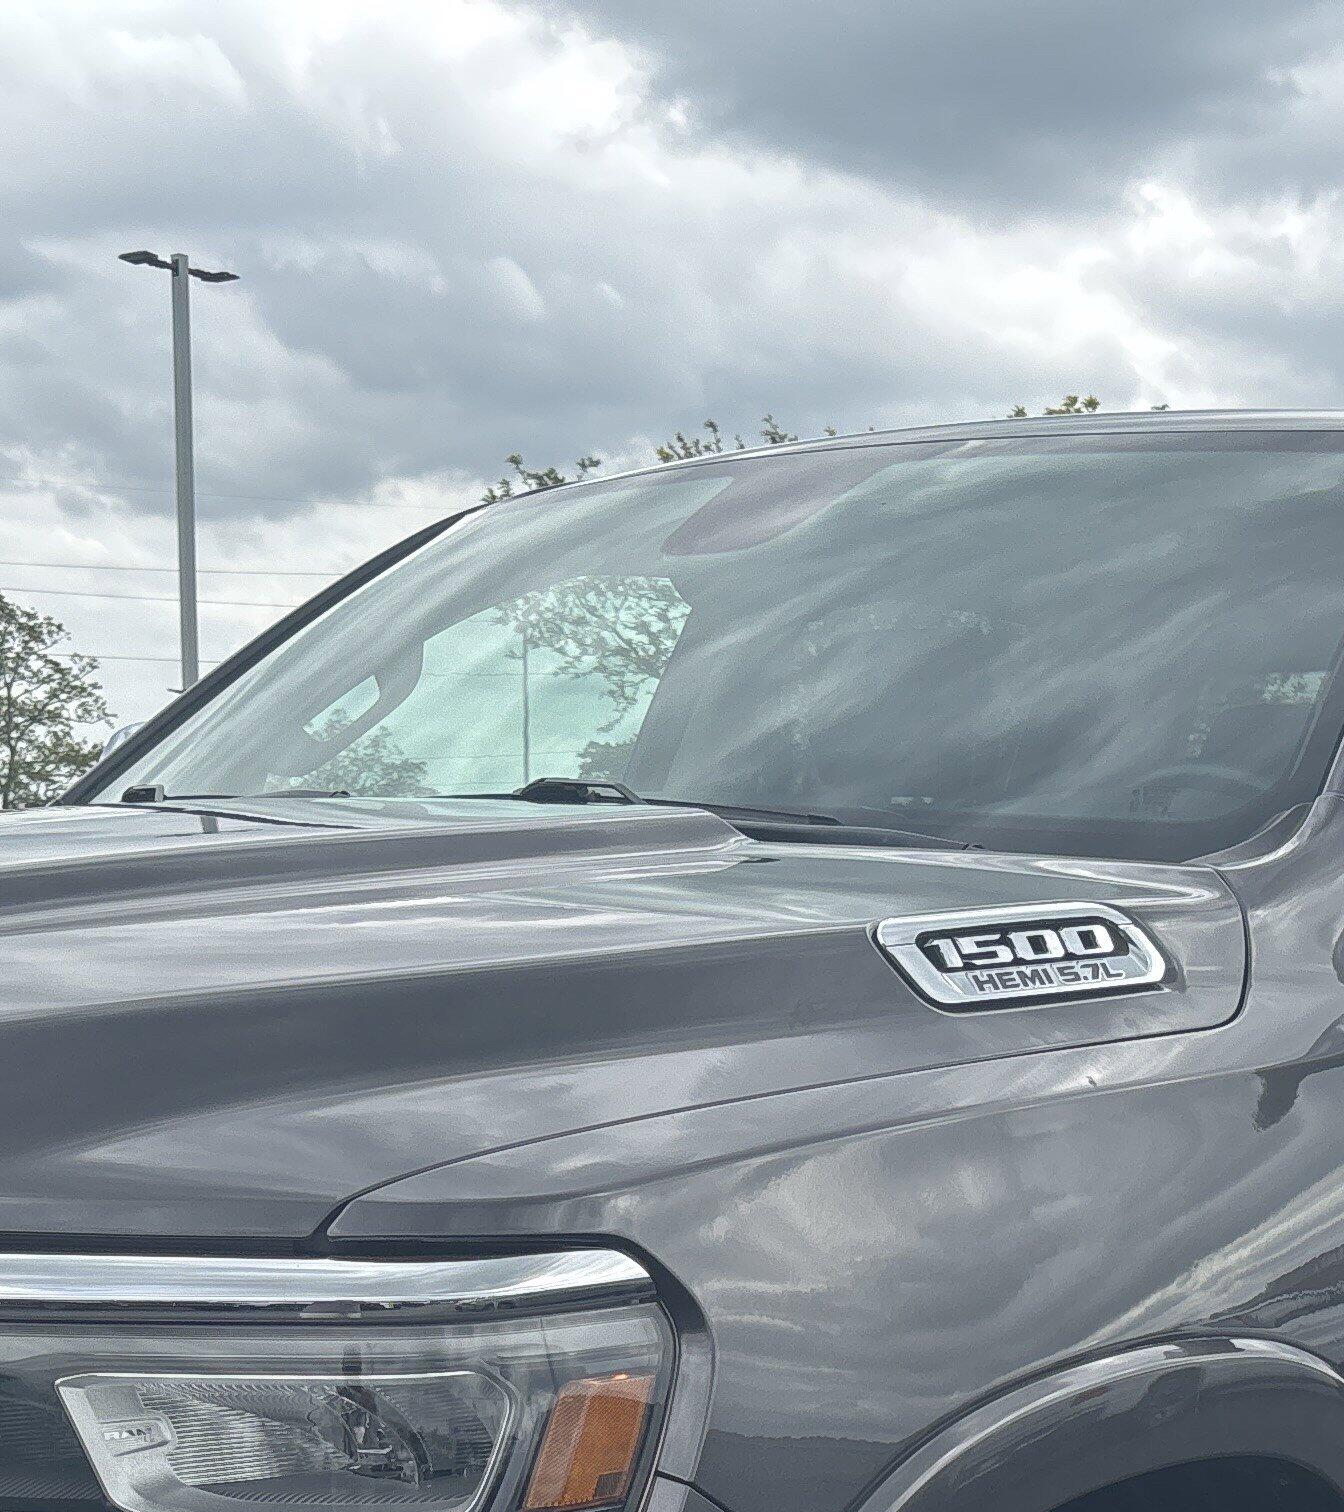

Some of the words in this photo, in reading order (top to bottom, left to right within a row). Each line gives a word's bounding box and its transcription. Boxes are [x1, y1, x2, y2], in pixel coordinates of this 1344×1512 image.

[923, 924, 1116, 968] 1500
[971, 967, 1053, 992] HEMI
[1057, 962, 1124, 983] 5.7L
